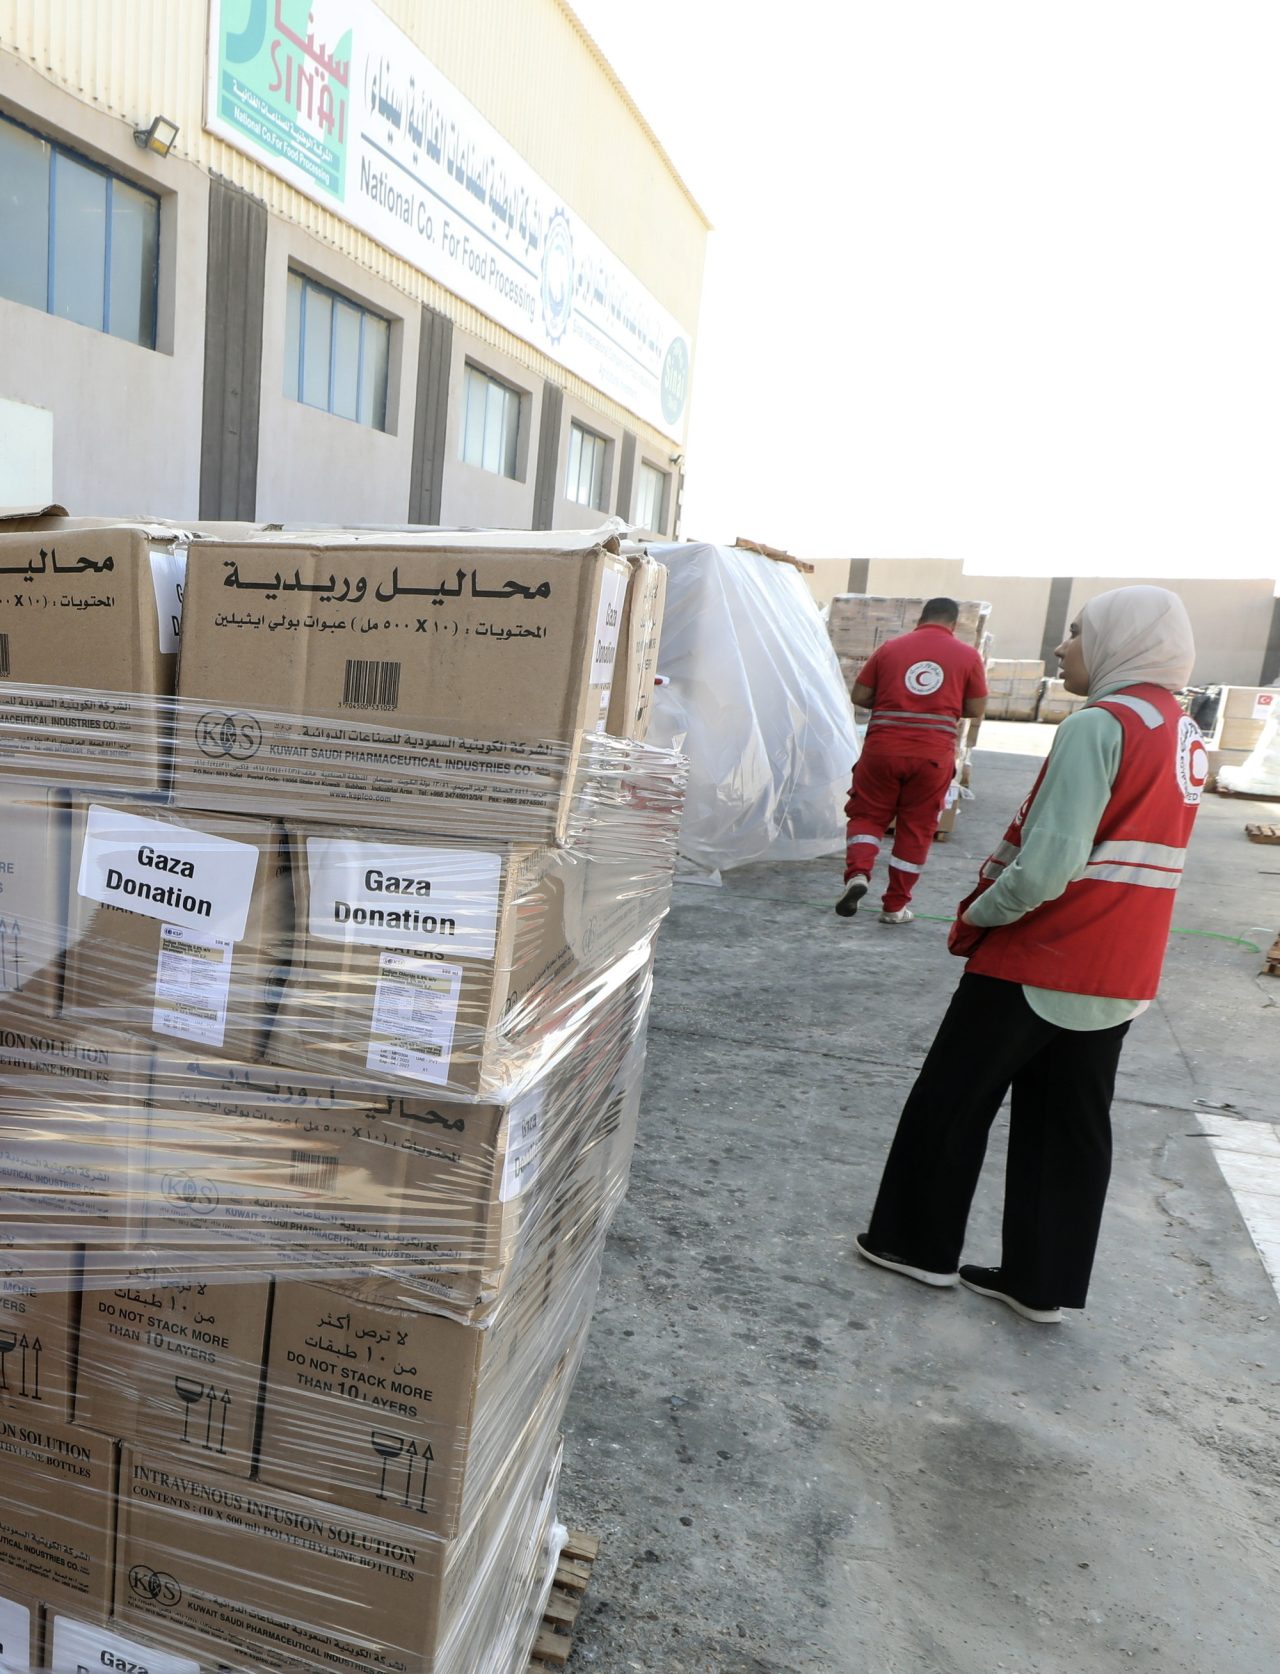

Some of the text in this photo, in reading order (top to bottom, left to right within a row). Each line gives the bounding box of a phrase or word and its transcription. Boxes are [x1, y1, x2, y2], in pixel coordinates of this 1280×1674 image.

[269, 39, 345, 144] SINAI
[234, 106, 261, 135] National
[283, 142, 299, 162] Food
[299, 154, 330, 185] Processing
[360, 155, 414, 227] National
[417, 201, 435, 243] Co.
[441, 220, 460, 262] For
[463, 234, 486, 280] Food
[489, 257, 536, 323] Processing
[222, 559, 552, 606] محاليل وريدية
[606, 602, 617, 628] Gaza
[596, 640, 615, 664] Donation
[270, 744, 534, 776] KUWAIT SAUDI PHARMACEUTICAL INDUSTRIES CO.
[137, 845, 195, 880] Gaza
[106, 868, 213, 917] Donation
[364, 869, 432, 897] Gaza
[334, 900, 457, 936] Donation
[30, 1037, 110, 1065] SOLUTION
[3, 1281, 37, 1298] MORE
[98, 1302, 229, 1349] DO NOT STACK MORE
[108, 1323, 216, 1363] THAN 10 LAYERS
[287, 1351, 433, 1401] DO NOT STACK MORE
[297, 1373, 418, 1417] THAN 10 LAYERS
[19, 1428, 91, 1462] SOLUTION
[133, 1465, 417, 1566] INTRAVENOUS INFUSION SOLUTION
[133, 1485, 191, 1512] CONTENTS
[225, 1513, 242, 1527] 500
[263, 1526, 357, 1564] POLYETHYLENE
[358, 1555, 415, 1582] BOTTLES
[23, 1544, 65, 1568] INDUSTRIES
[67, 1561, 80, 1571] CO.
[100, 1650, 149, 1674] Gaza
